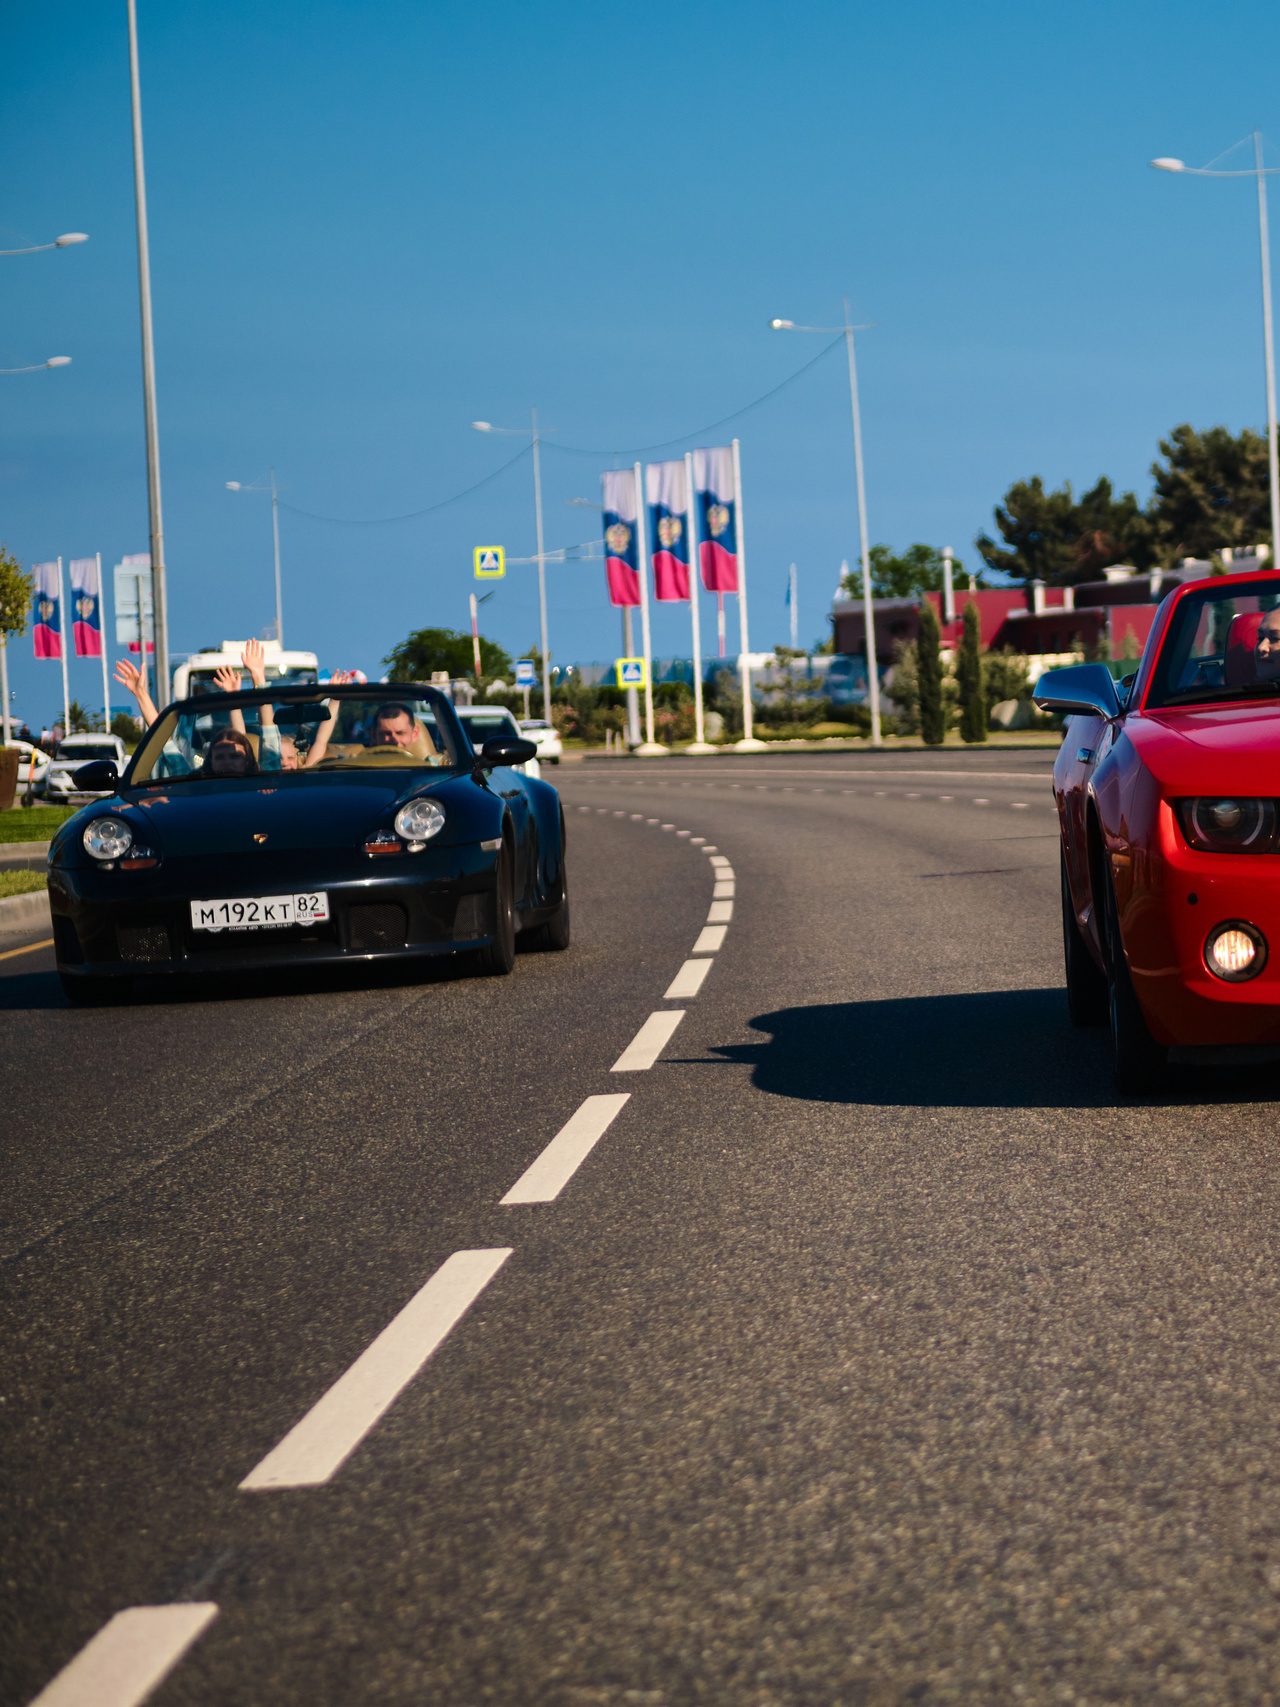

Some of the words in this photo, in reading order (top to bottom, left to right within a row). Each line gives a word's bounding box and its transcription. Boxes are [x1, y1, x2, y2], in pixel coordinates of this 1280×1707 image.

[200, 902, 290, 925] М192КТ
[298, 896, 319, 912] 82
[296, 910, 313, 919] RUS
